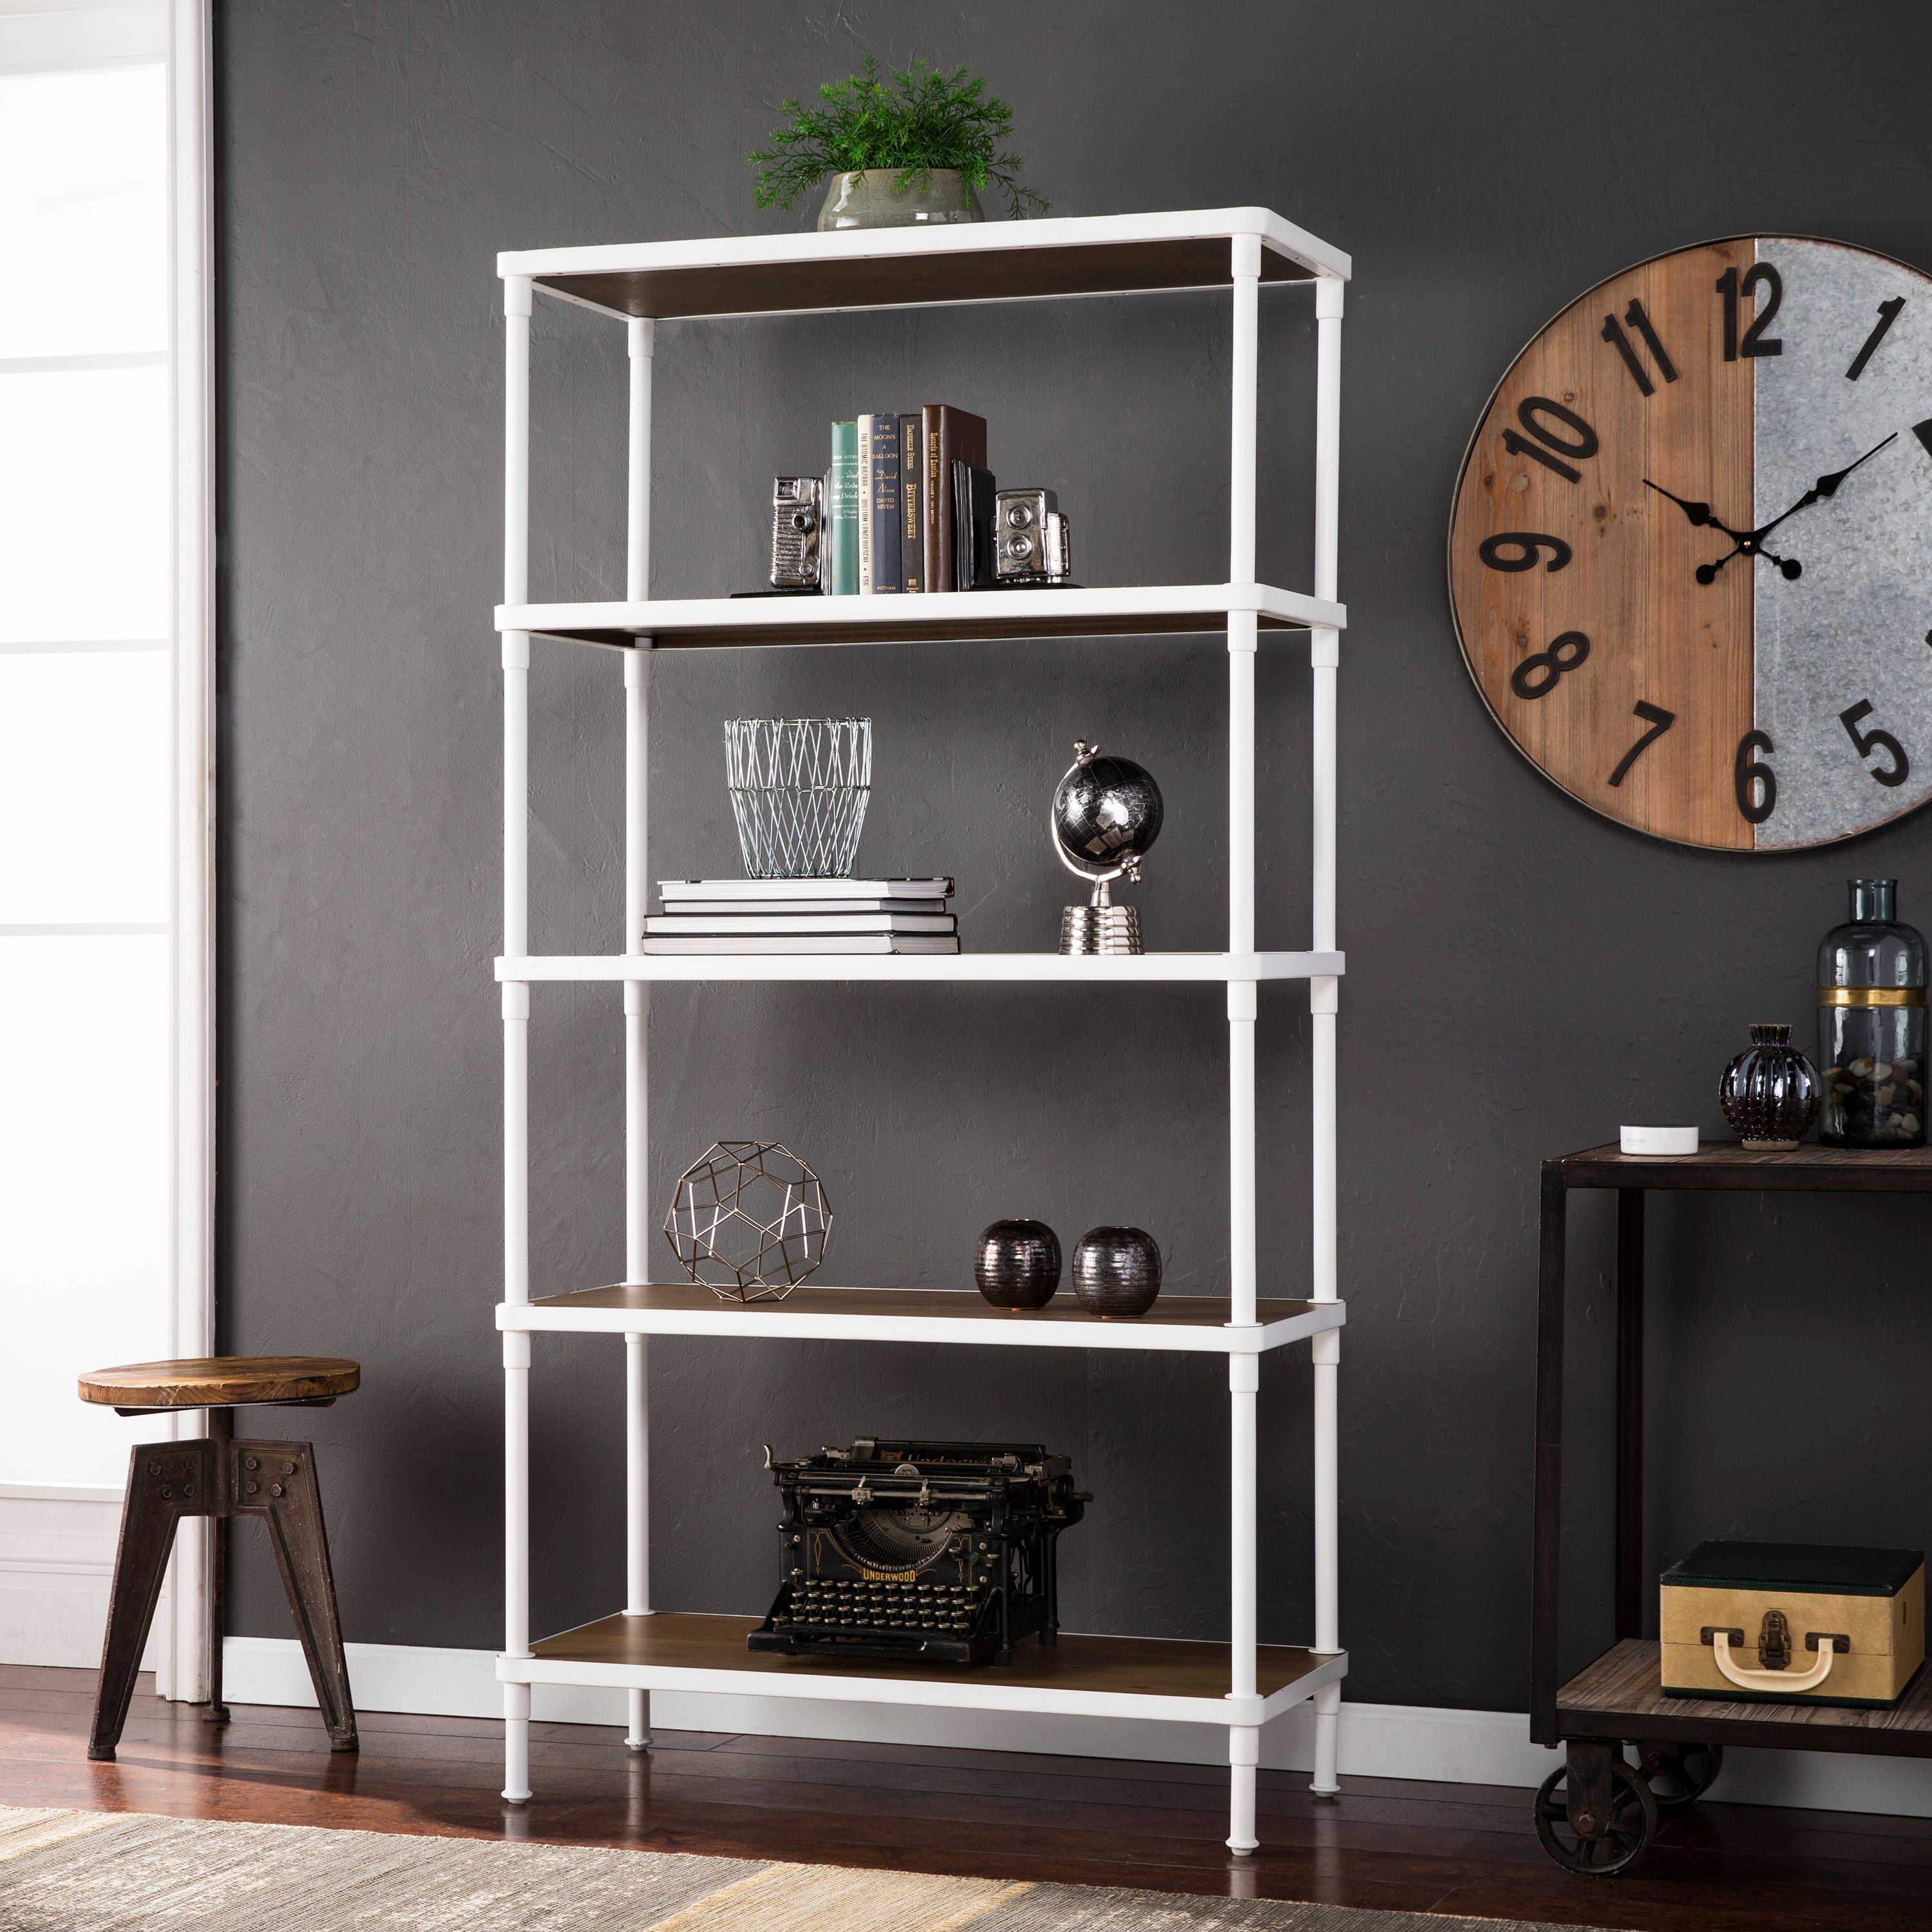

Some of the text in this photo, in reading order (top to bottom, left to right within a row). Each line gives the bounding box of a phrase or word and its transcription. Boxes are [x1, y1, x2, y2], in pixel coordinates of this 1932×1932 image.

[1716, 262, 1782, 361] 12
[1846, 296, 1906, 381] 1
[1601, 298, 1678, 396] 11
[930, 432, 938, 451] Records
[930, 459, 938, 478] Exotics
[1502, 396, 1599, 484] 10
[875, 469, 898, 480] David
[876, 482, 895, 493] Niven
[906, 484, 916, 539] BITTERSWEET
[1480, 532, 1571, 572] 9
[1511, 631, 1590, 699] 8
[1609, 700, 1674, 786] 7
[1839, 699, 1909, 786] 5
[1735, 730, 1777, 824] 6
[863, 1567, 916, 1582] UNDERWOOD
